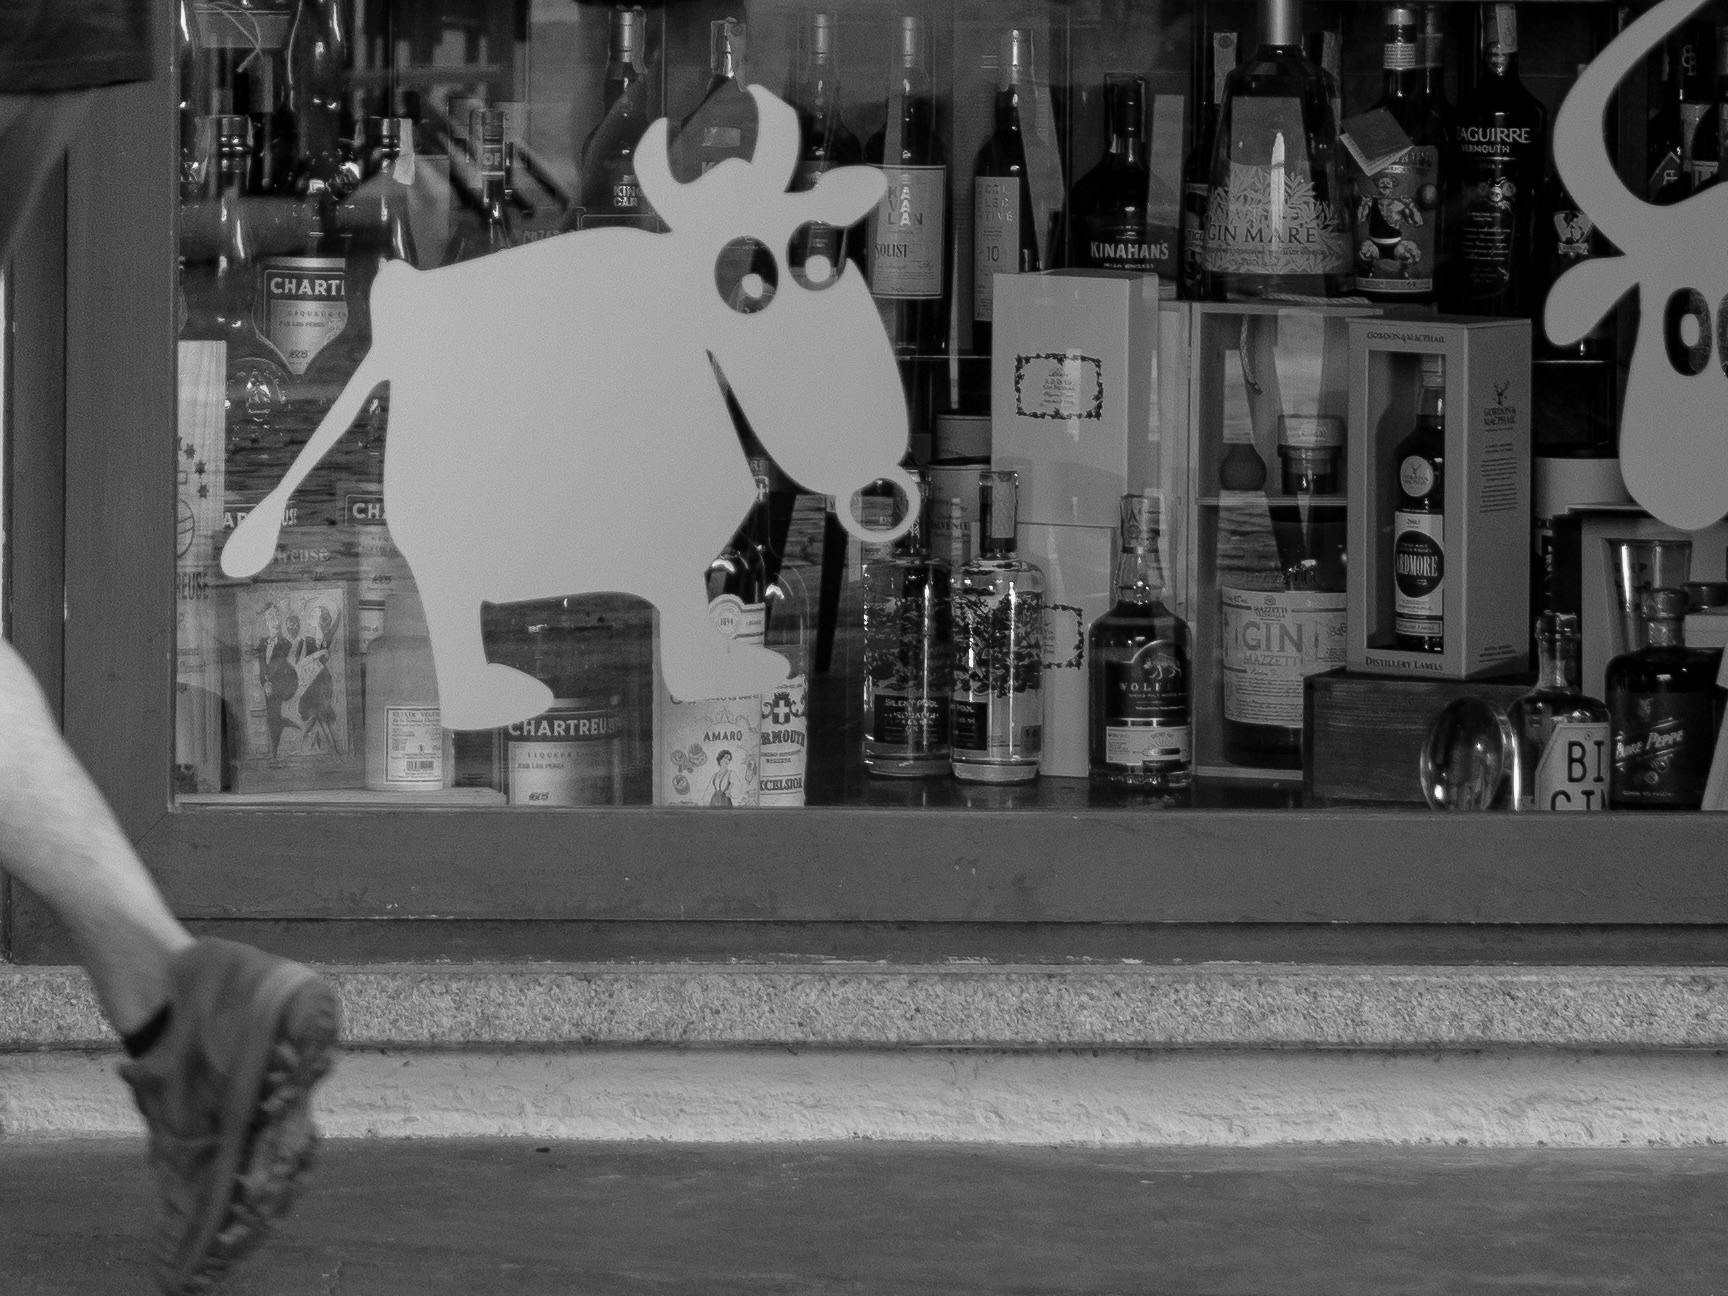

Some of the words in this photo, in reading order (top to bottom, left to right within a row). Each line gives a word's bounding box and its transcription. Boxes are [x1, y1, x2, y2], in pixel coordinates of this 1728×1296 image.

[1207, 224, 1238, 242] GIN
[1244, 225, 1316, 244] MARE
[986, 245, 999, 261] 10
[1090, 240, 1169, 259] KINAHAN'S
[1242, 620, 1304, 653] GIN
[1365, 655, 1412, 669] DISTILLERY
[1414, 658, 1444, 671] LABELS
[703, 730, 743, 742] AMARO
[760, 778, 803, 792] XCELSIOR
